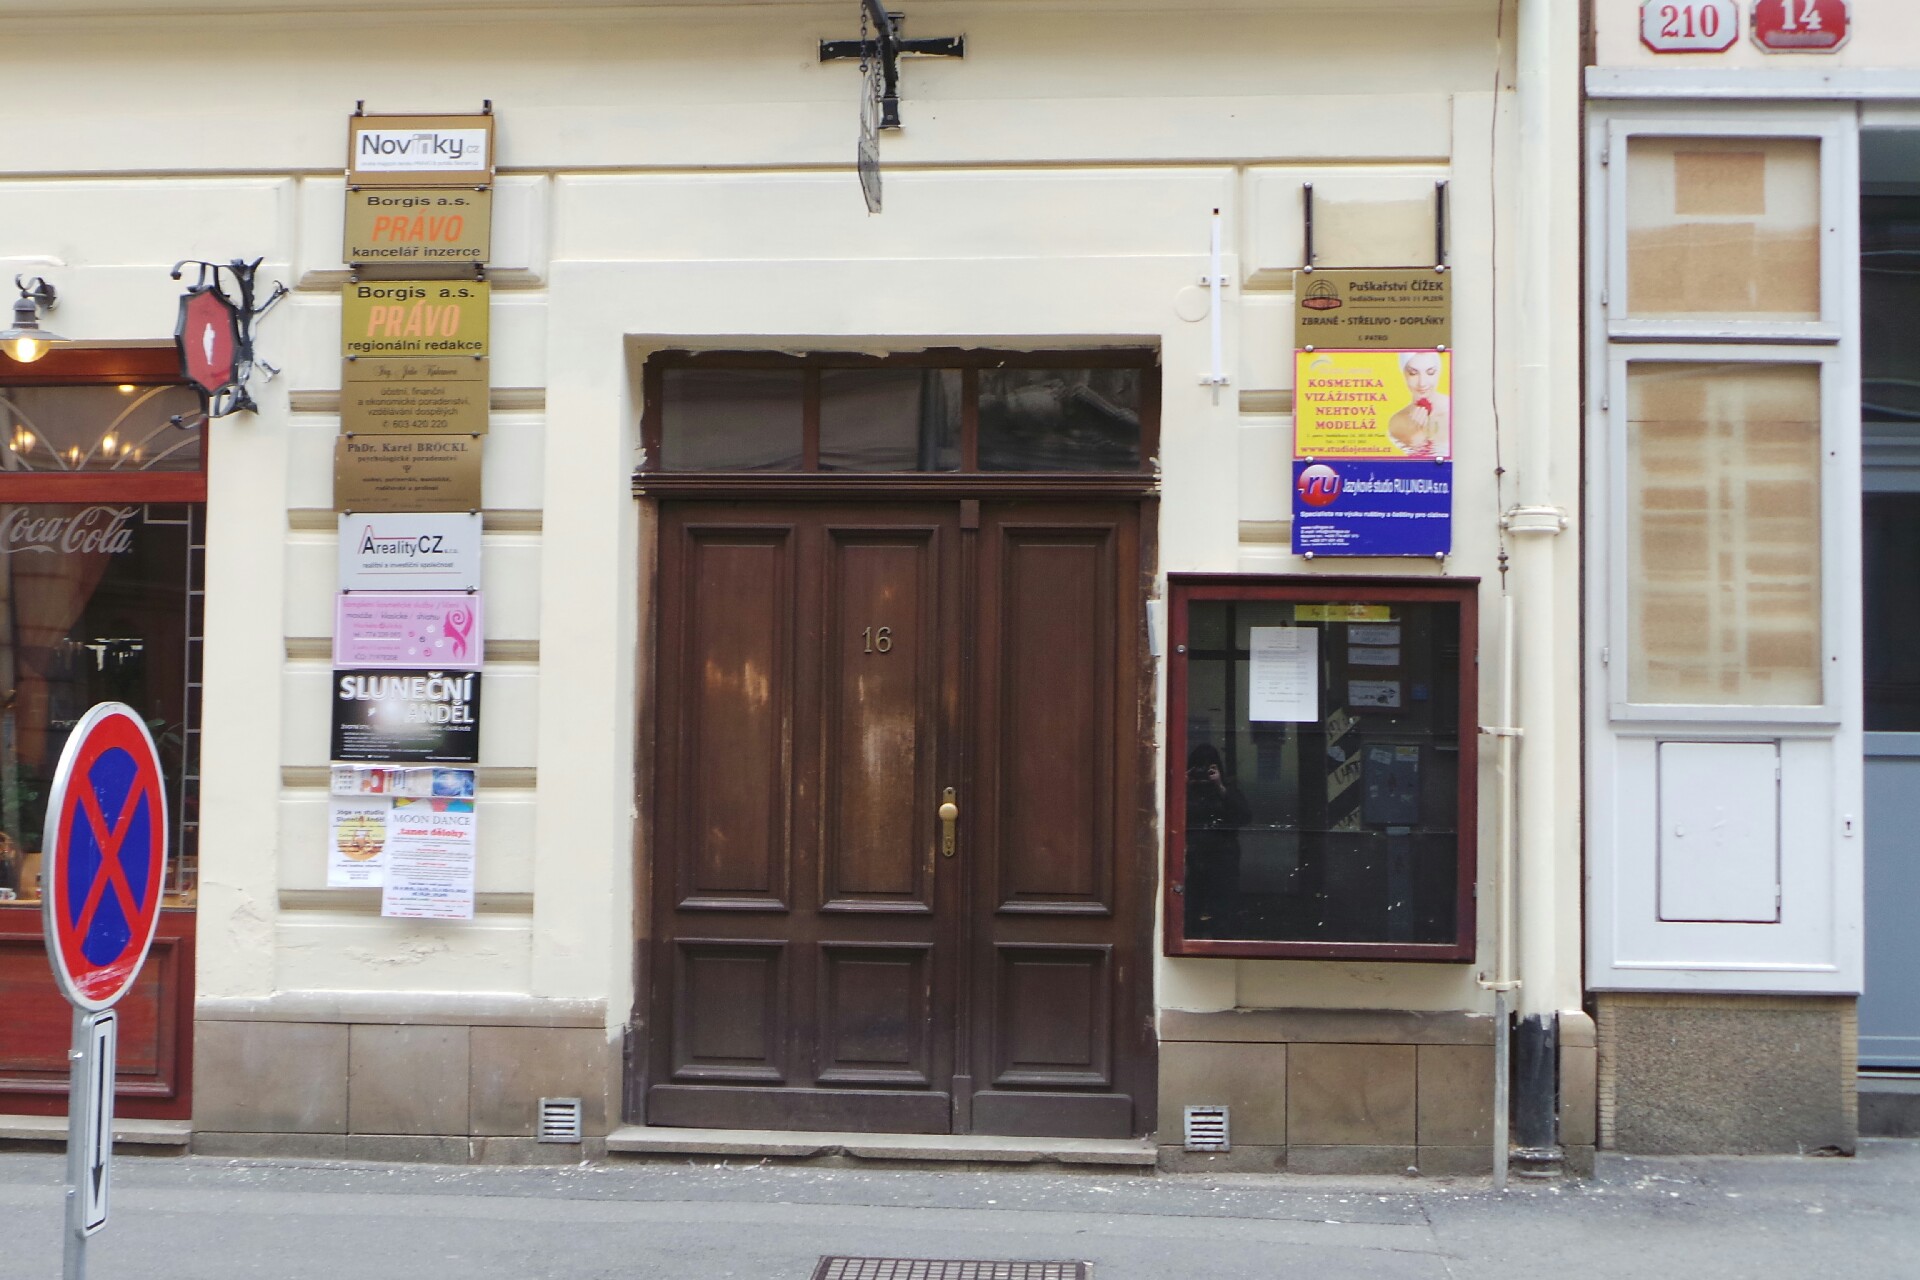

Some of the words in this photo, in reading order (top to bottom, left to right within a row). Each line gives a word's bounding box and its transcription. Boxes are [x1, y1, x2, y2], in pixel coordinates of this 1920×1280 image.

[1660, 4, 1719, 38] 210
[1781, 0, 1822, 30] 14
[367, 196, 430, 207] Borgis
[437, 197, 470, 206] a.s.
[371, 208, 464, 242] PRÁVO
[352, 246, 419, 257] kancelář
[424, 246, 481, 257] inzerce
[1349, 281, 1408, 292] Puškařství
[357, 286, 426, 301] Borgis
[439, 287, 475, 298] a.s.
[367, 300, 460, 337] PRÁVO
[1347, 315, 1391, 326] STŘELIVO
[347, 340, 421, 352] regionální
[424, 340, 483, 351] redakce
[1308, 379, 1384, 388] KOSMETIKA
[1304, 390, 1388, 402] VIZÁŽISTIKA
[1315, 404, 1376, 416] NEHTOVÁ
[1315, 417, 1376, 430] MODELÁŽ
[347, 443, 377, 452] PhDr.
[382, 442, 412, 452] Karel
[0, 505, 142, 554] Coca-Cola
[862, 626, 893, 653] 16
[338, 670, 475, 702] SLUNEČNÍ
[393, 814, 430, 825] MOON
[432, 816, 471, 826] DANCE
